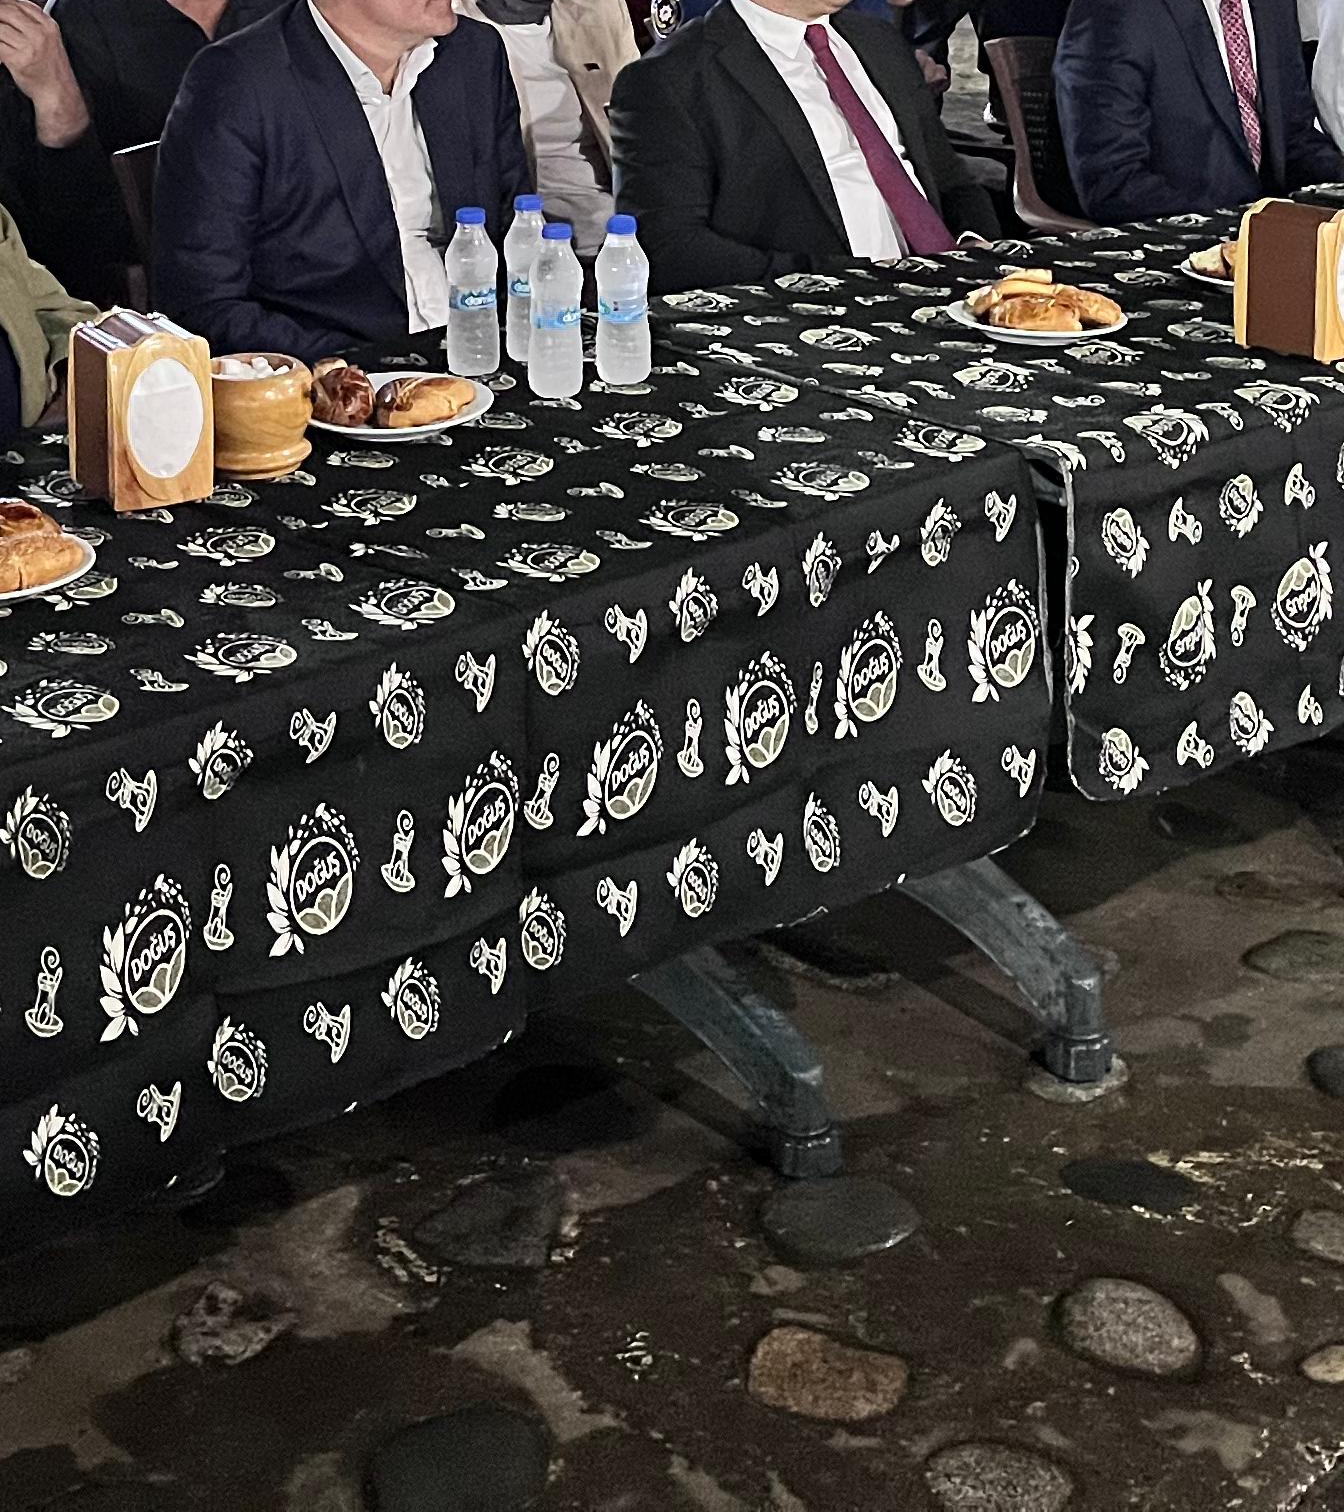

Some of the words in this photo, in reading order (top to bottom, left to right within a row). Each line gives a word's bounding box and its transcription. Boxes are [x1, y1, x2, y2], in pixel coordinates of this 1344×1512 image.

[991, 620, 1027, 660] DOĞUŞ
[854, 651, 890, 694] DOĞUŞ
[744, 694, 780, 739] DOĞUŞ
[611, 742, 650, 791] DOĞUŞ
[467, 795, 506, 845] DOĞUŞ
[296, 851, 340, 901] DOĞUŞ
[131, 923, 176, 981] DOĞUŞ
